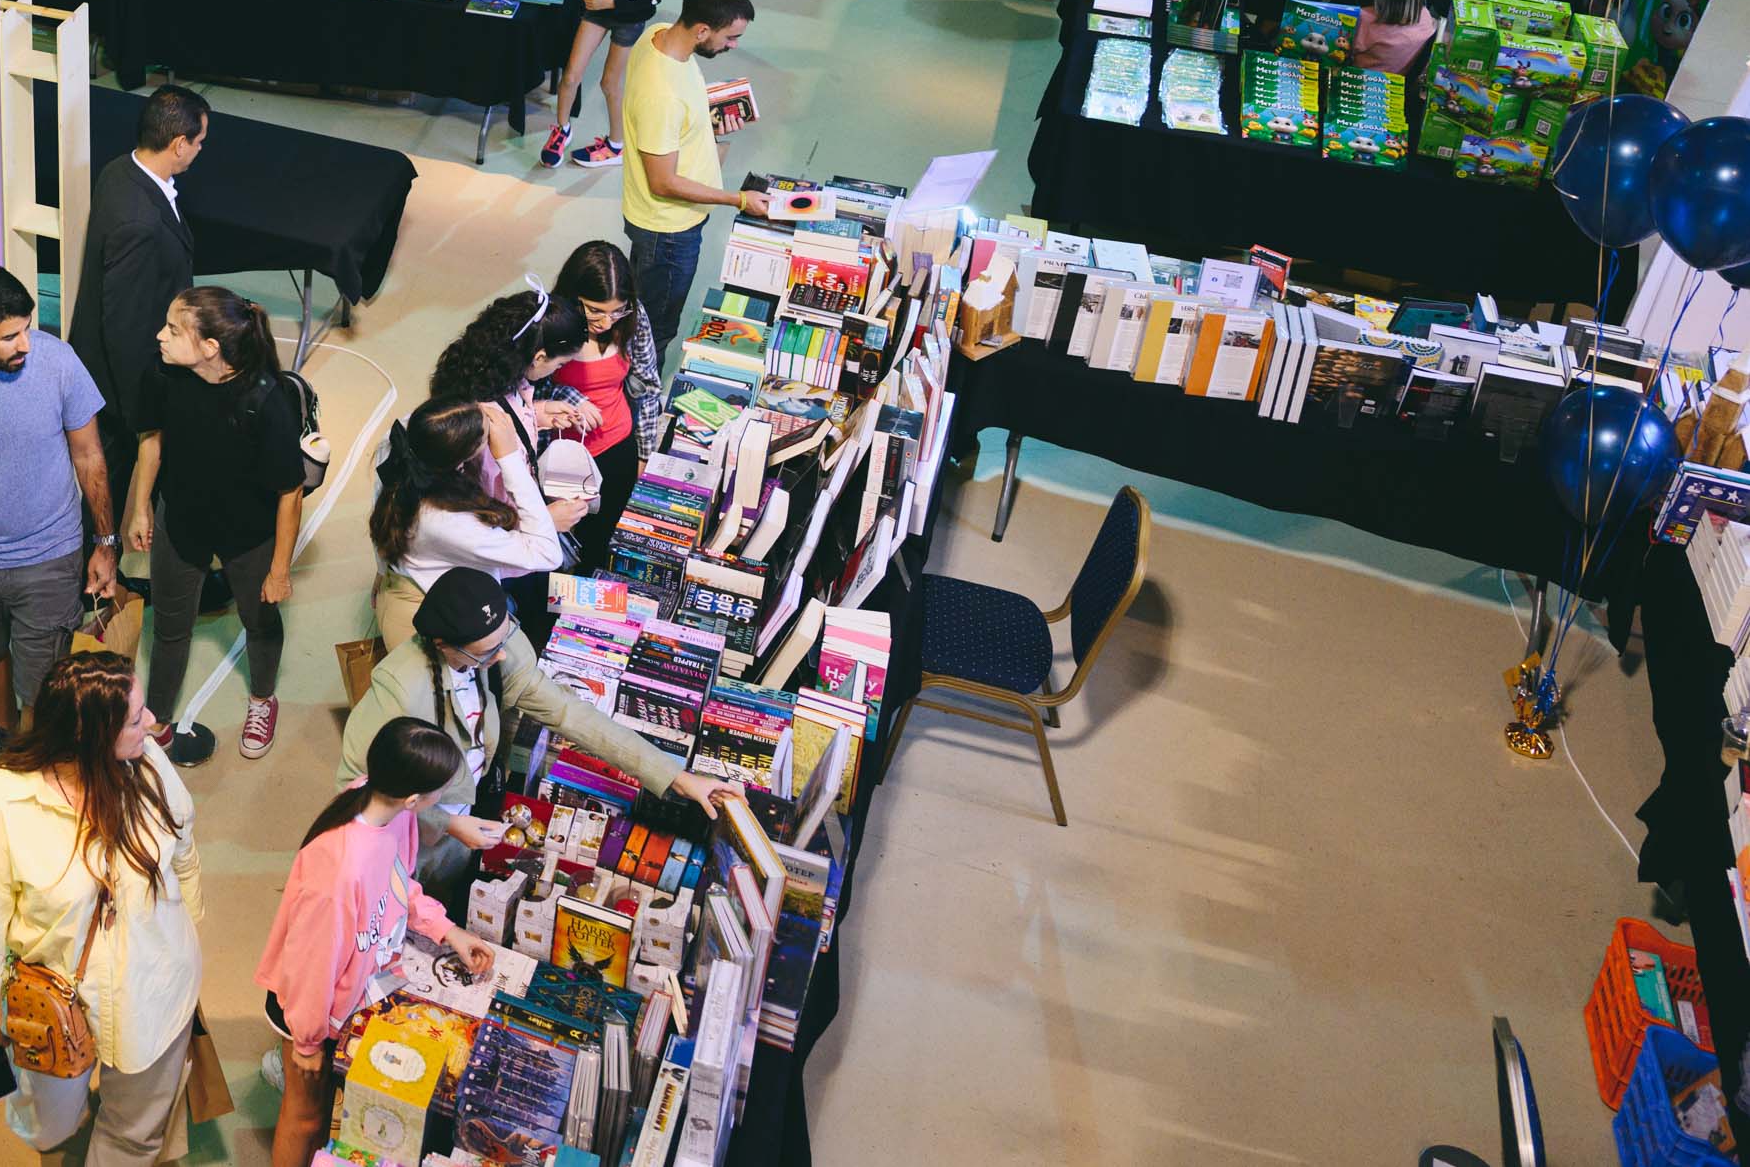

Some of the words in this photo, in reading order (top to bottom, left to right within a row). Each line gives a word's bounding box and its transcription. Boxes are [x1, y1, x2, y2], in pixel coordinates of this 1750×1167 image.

[707, 316, 727, 344] BODY
[580, 580, 593, 605] Read
[595, 580, 612, 611] Beach
[696, 588, 712, 612] ion
[734, 597, 758, 624] dec
[673, 656, 700, 669] TRAPPED
[825, 665, 878, 691] Hay
[568, 926, 616, 952] POTTER
[571, 917, 615, 940] HARRY
